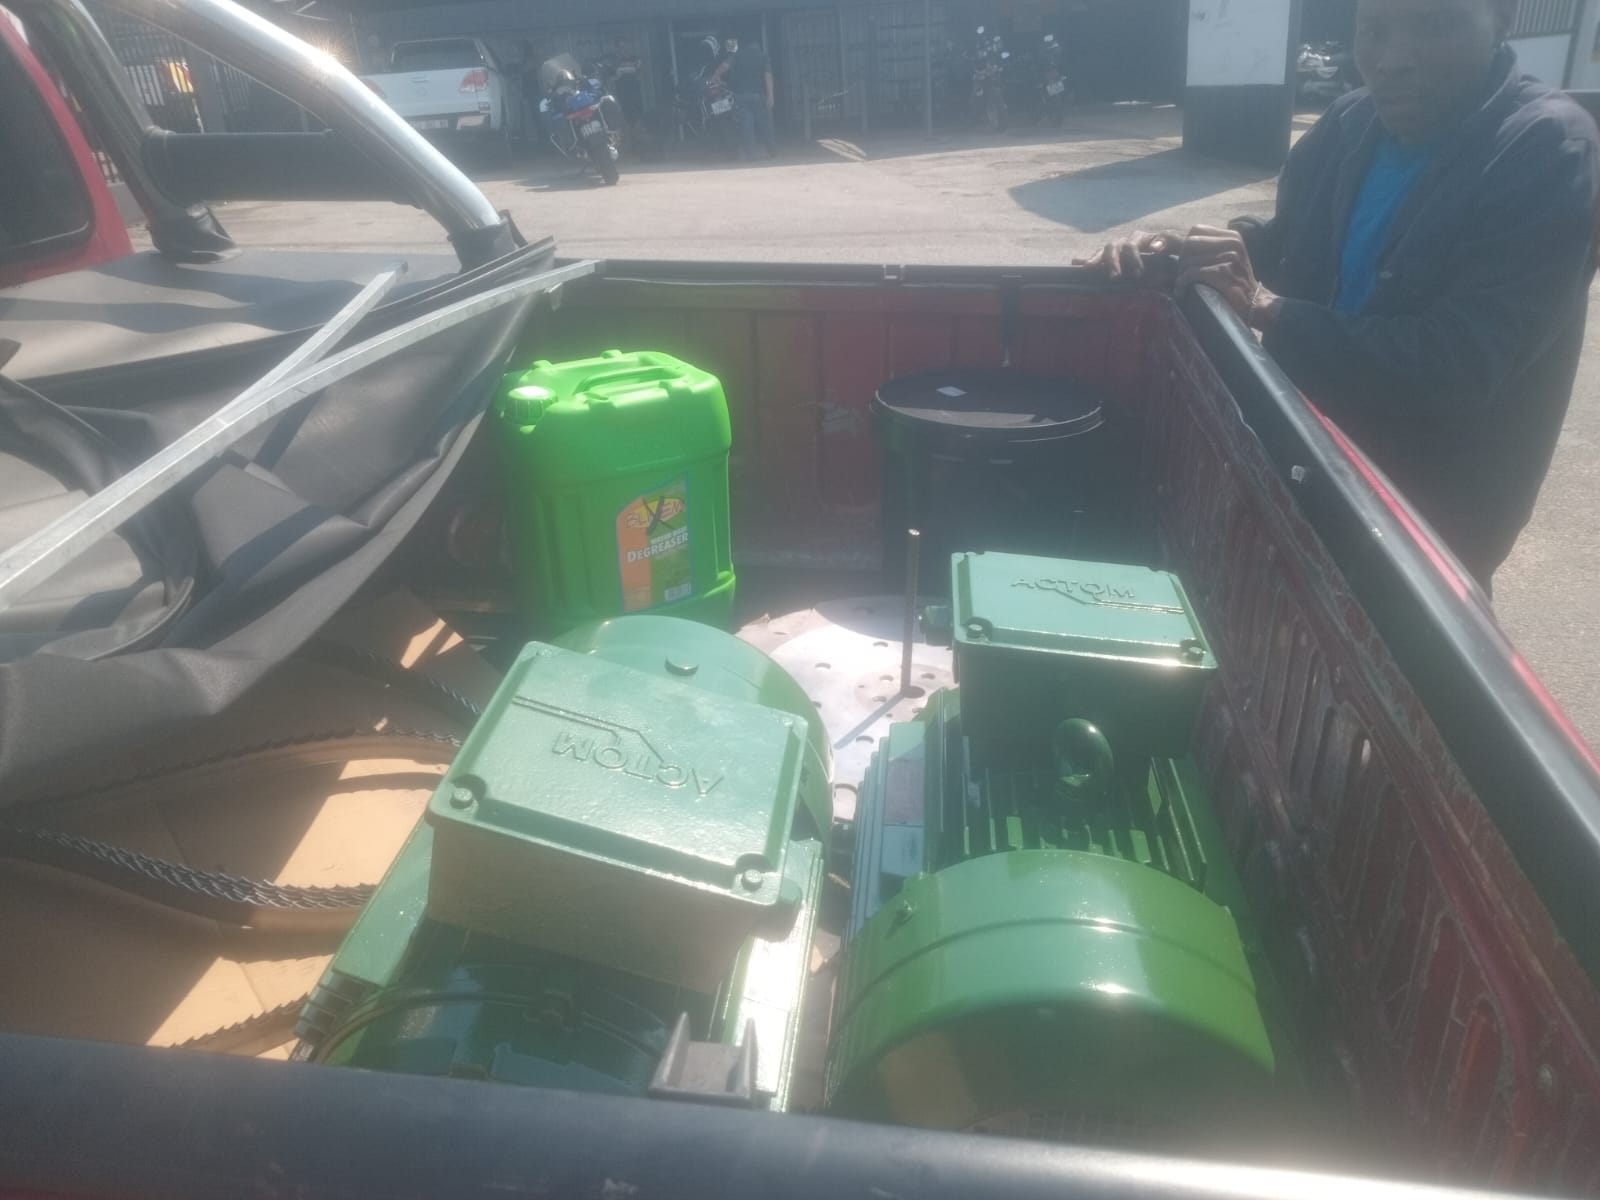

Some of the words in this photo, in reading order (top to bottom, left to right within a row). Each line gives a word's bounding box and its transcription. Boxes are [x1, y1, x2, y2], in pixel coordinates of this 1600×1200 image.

[627, 532, 688, 563] DEGREASER
[1010, 578, 1136, 599] ACTOM
[551, 731, 725, 797] ACTOM
